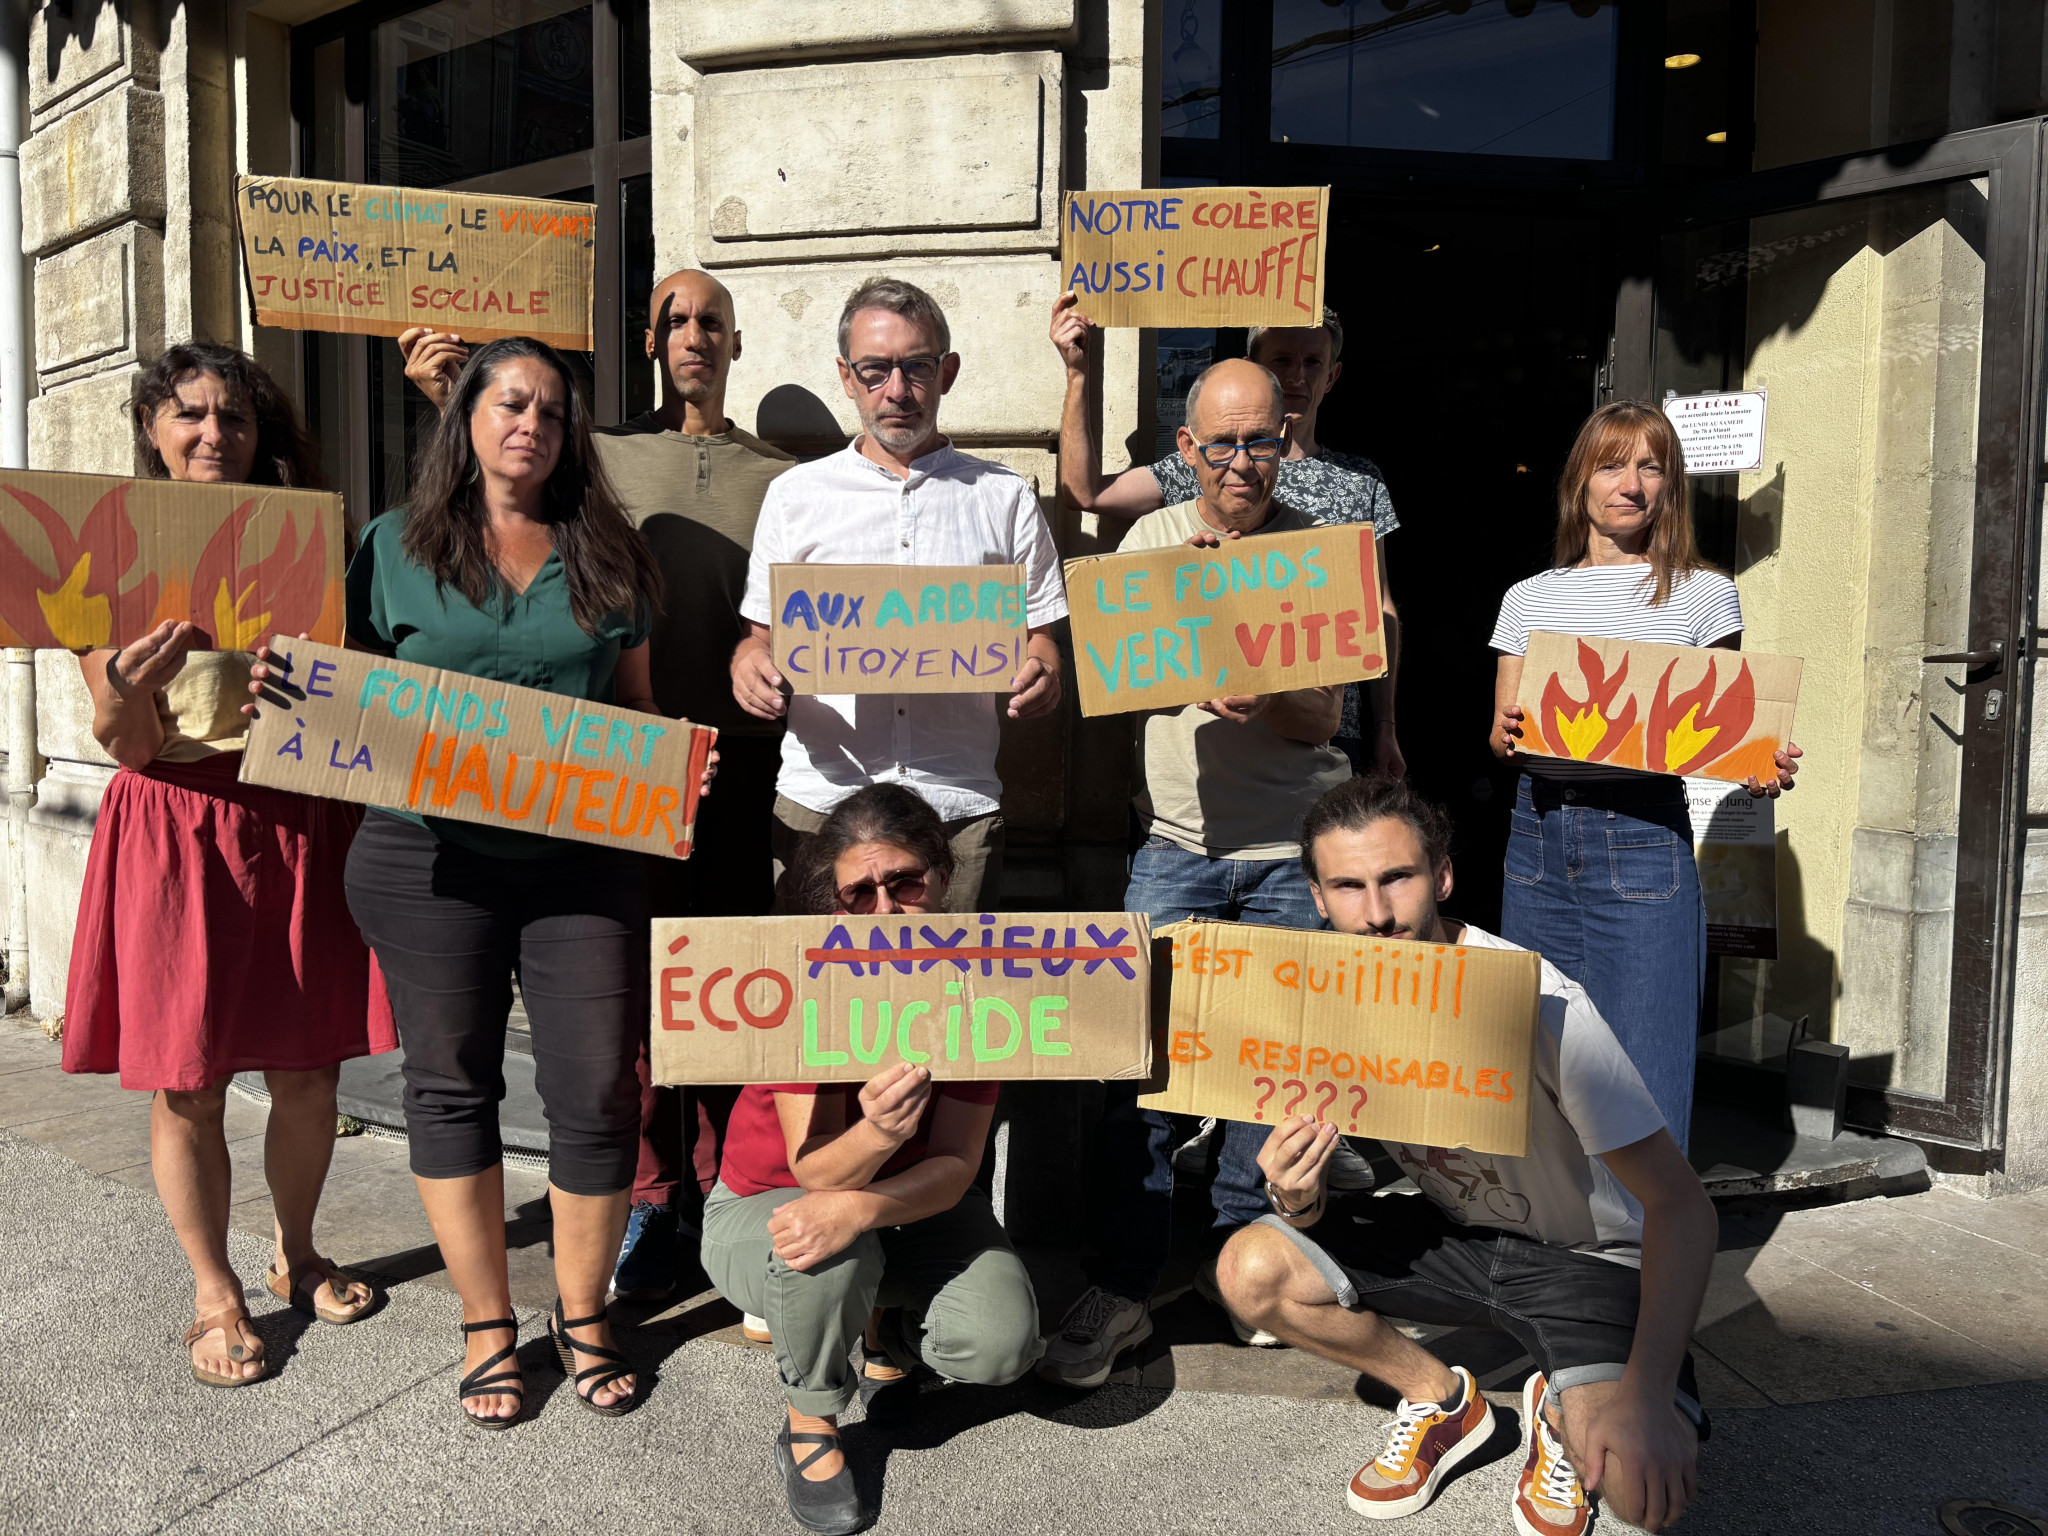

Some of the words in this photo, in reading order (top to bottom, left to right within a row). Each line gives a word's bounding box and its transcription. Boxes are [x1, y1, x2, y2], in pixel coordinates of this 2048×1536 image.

[249, 186, 319, 217] POUR
[327, 193, 352, 217] LE
[460, 208, 487, 230] LE
[1070, 198, 1184, 235] NOTRE
[1192, 190, 1318, 230] COLÈRE
[254, 236, 286, 256] LA
[381, 247, 417, 267] ET
[428, 251, 459, 273] LA
[1176, 232, 1318, 312] CHAUFFE
[1685, 402, 1700, 411] LE
[1095, 570, 1151, 614] LE
[1175, 546, 1328, 602] FONDS
[781, 589, 865, 632] AUX
[1085, 615, 1227, 695] VERT,
[280, 651, 338, 698] LE
[358, 668, 510, 738] FONDS
[540, 705, 666, 768] VERT
[277, 716, 306, 761] À
[328, 739, 374, 773] LA
[1715, 795, 1722, 806] à
[1726, 796, 1753, 809] Jung
[658, 935, 794, 1032] ÉCO
[1238, 1037, 1514, 1102] RESPONSABLES
